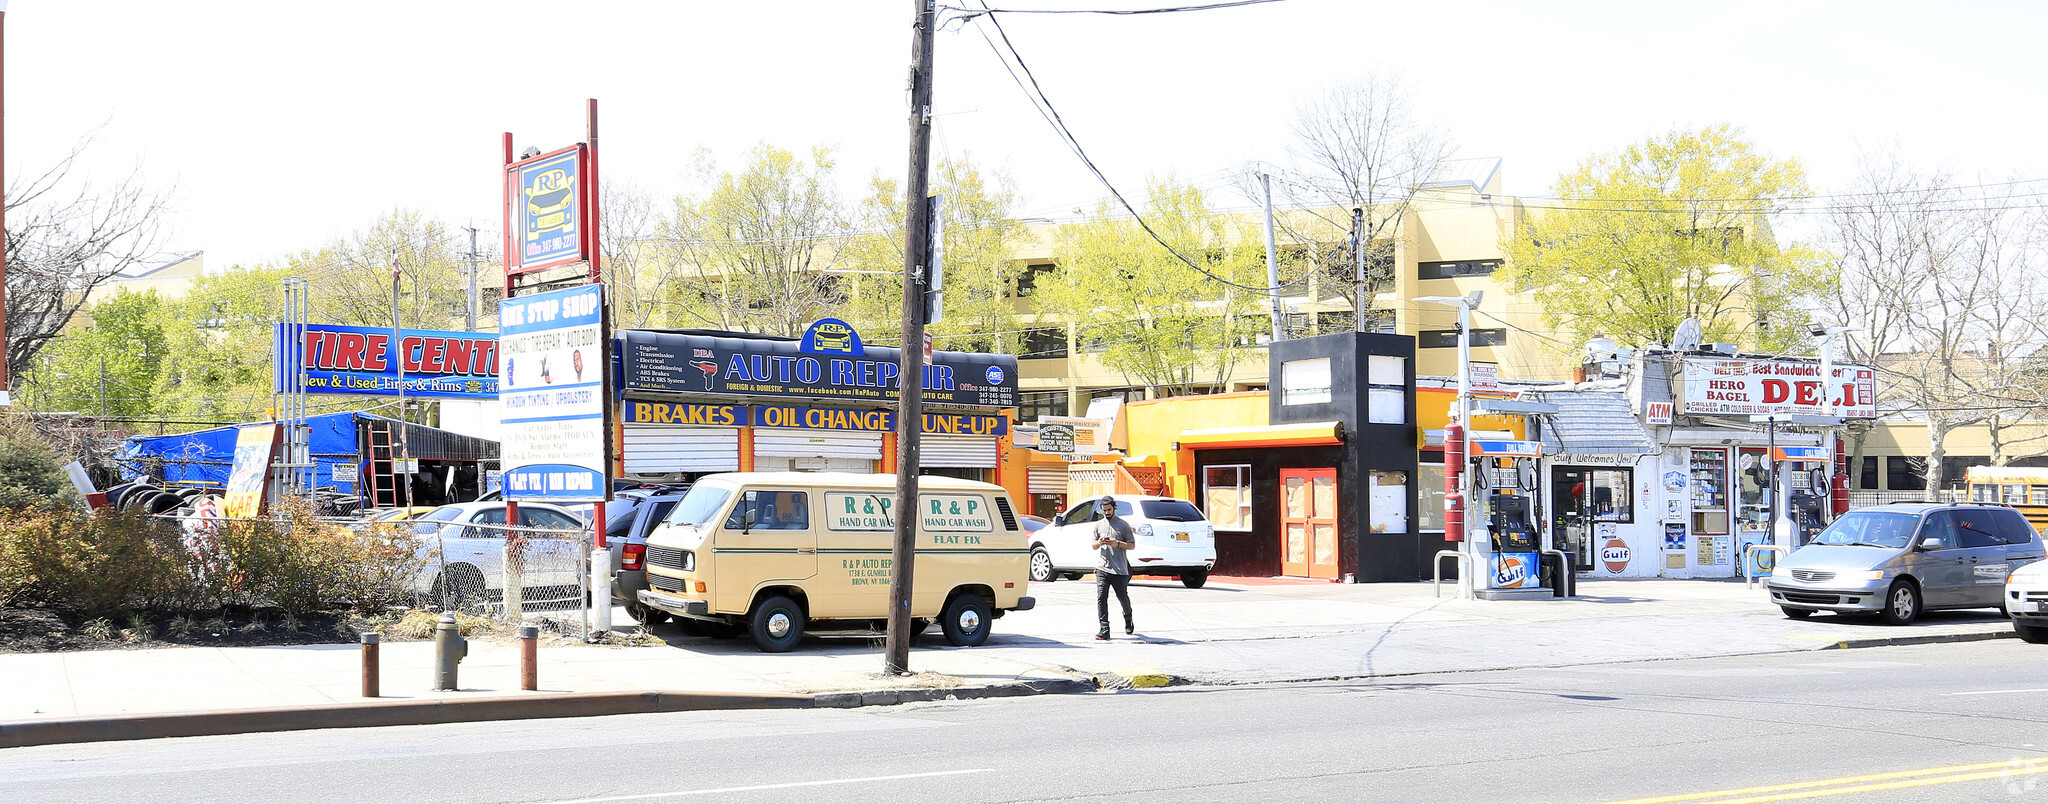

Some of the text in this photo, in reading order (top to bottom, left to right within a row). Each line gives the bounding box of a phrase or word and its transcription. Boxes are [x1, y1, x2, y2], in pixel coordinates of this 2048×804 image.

[527, 242, 542, 256] Office
[501, 292, 598, 328] ONE STOP SHOP
[531, 335, 542, 351] TIRE
[543, 332, 561, 350] REPAIR
[567, 329, 580, 348] AUTO
[582, 328, 597, 346] BODY
[299, 330, 499, 377] TIRE CENT
[639, 351, 674, 359] Transmission
[649, 364, 683, 372] Conditioning
[724, 353, 822, 384] AUTO
[1752, 363, 1772, 375] Best
[1774, 363, 1815, 376] Sandwich
[331, 374, 343, 388] &
[346, 375, 379, 389] Used
[416, 377, 427, 391] &
[431, 378, 462, 392] Rims
[726, 382, 749, 391] FOREIGN
[756, 384, 783, 393] DOMESTIC
[959, 383, 978, 391] Office
[1709, 380, 1746, 391] HERO
[506, 395, 526, 408] WINDOW
[528, 393, 549, 407] TINTING
[556, 390, 593, 405] UPHOLSTERY
[937, 392, 954, 400] CARE
[1706, 391, 1750, 402] BAGEL
[635, 402, 735, 426] BRAKES
[1648, 403, 1670, 418] ATM
[1720, 403, 1730, 413] ATM
[1731, 404, 1742, 413] COLD
[1742, 405, 1753, 413] BEER
[764, 406, 890, 431] OIL CHANGE
[921, 414, 998, 435] UNE-UP
[1040, 425, 1074, 436] REGISTERED
[1506, 443, 1518, 452] FULL
[1553, 453, 1632, 467] Gulf Welcomes You
[230, 495, 253, 513] CAR
[844, 496, 892, 515] R & P
[930, 499, 978, 515] R & P
[839, 517, 895, 528] HAND CAR WAS
[924, 518, 986, 527] HAND CAR WASH
[934, 535, 981, 544] FLAT FIX
[1603, 550, 1629, 559] Gulf
[842, 559, 847, 569] R
[849, 559, 854, 569] &
[855, 559, 860, 569] P
[862, 559, 879, 569] AUTO
[848, 569, 860, 577] 1738
[867, 569, 887, 577] GUNHILL
[1497, 566, 1524, 584] Gulf
[852, 578, 870, 586] BRONX,
